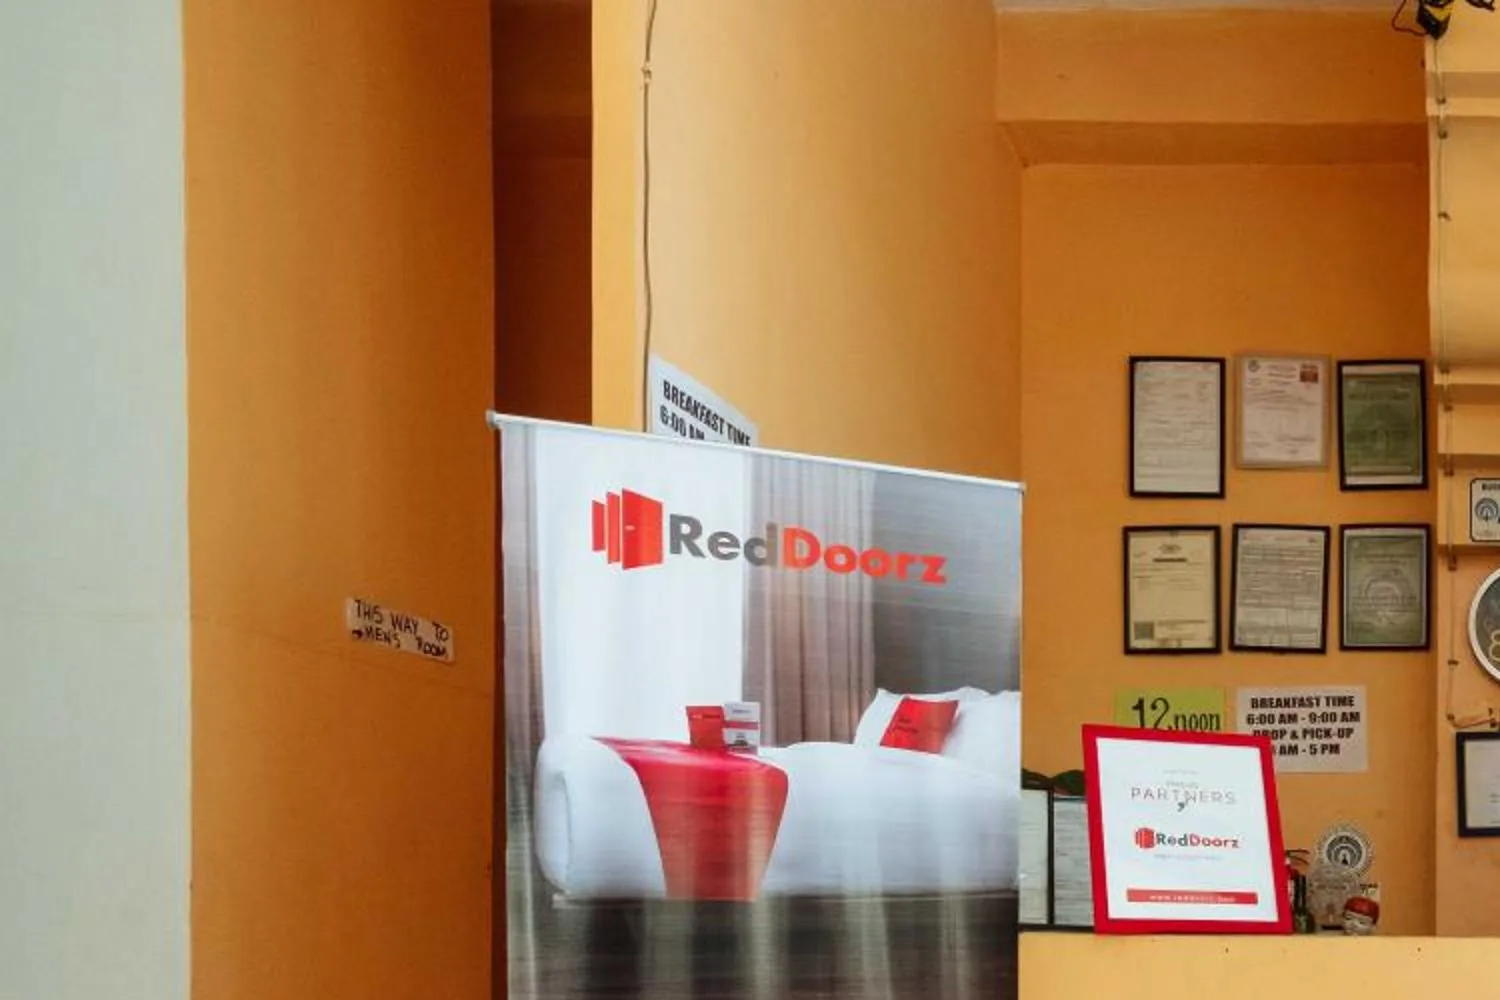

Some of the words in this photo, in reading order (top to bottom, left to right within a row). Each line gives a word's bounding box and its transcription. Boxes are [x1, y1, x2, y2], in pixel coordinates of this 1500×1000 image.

[663, 379, 726, 436] BREAKFAST
[668, 513, 947, 586] RedDoorz
[390, 612, 419, 636] WAY
[432, 621, 449, 642] TO
[1251, 697, 1321, 709] BREAKFAST
[1324, 695, 1355, 707] TIME
[1174, 713, 1220, 731] noon
[1246, 713, 1275, 725] 6:00
[1278, 713, 1298, 724] AM
[1308, 711, 1337, 724] 9:00
[1341, 711, 1361, 722] AM
[1302, 727, 1354, 740] PICK-UP
[1280, 744, 1299, 755] AM
[1309, 744, 1317, 755] 5
[1321, 743, 1340, 754] PM
[1130, 787, 1236, 805] PARTNERS
[1155, 832, 1241, 849] RedDoorz
